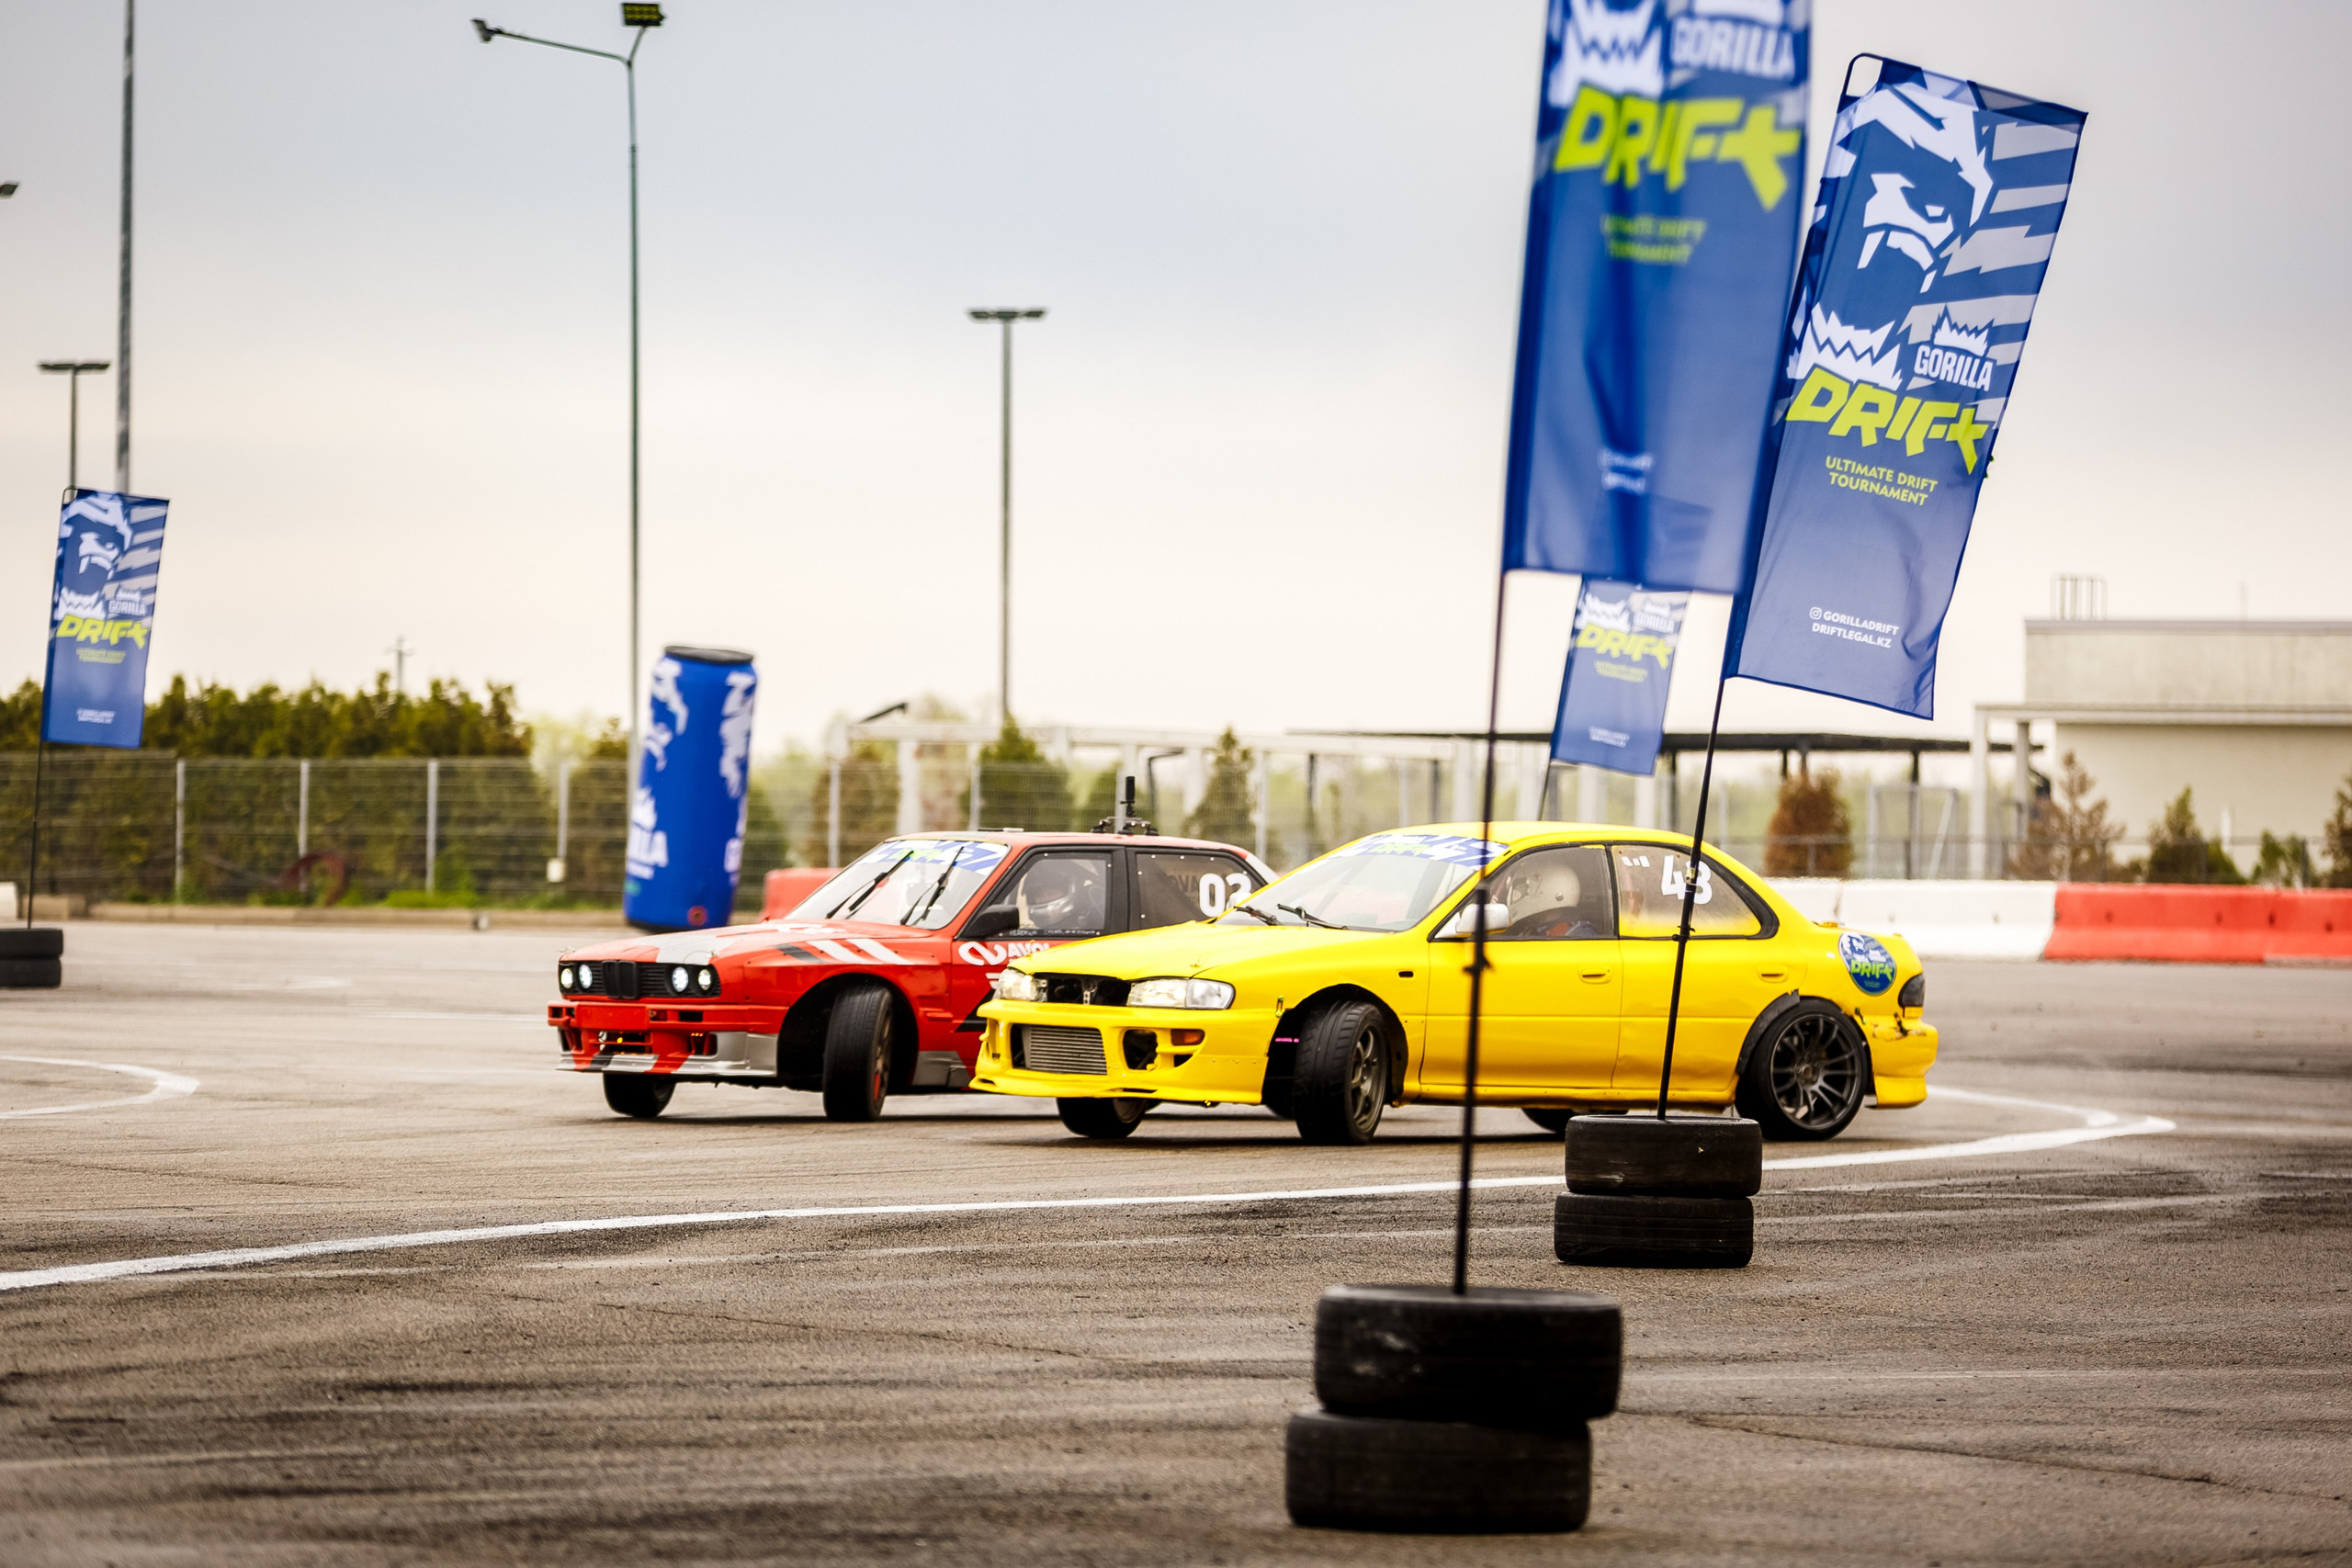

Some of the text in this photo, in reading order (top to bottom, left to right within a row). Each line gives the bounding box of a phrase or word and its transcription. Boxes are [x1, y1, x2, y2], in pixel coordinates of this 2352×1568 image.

[1669, 16, 1794, 78] GORILLA
[1554, 85, 1801, 211] DRIFT
[1914, 344, 1994, 392] GORILLA
[1785, 367, 1989, 475] DRIFT
[1825, 455, 1938, 492] ULTIMATE DRIFT
[1829, 472, 1928, 506] TOURNAMENT
[56, 614, 148, 649] DRIFT
[1812, 622, 1892, 649] DRIFTLEGAL.KZ
[1823, 611, 1899, 636] GORILLADRIFT
[1576, 622, 1672, 670] DRIFT
[1851, 959, 1893, 981] DRIFT
